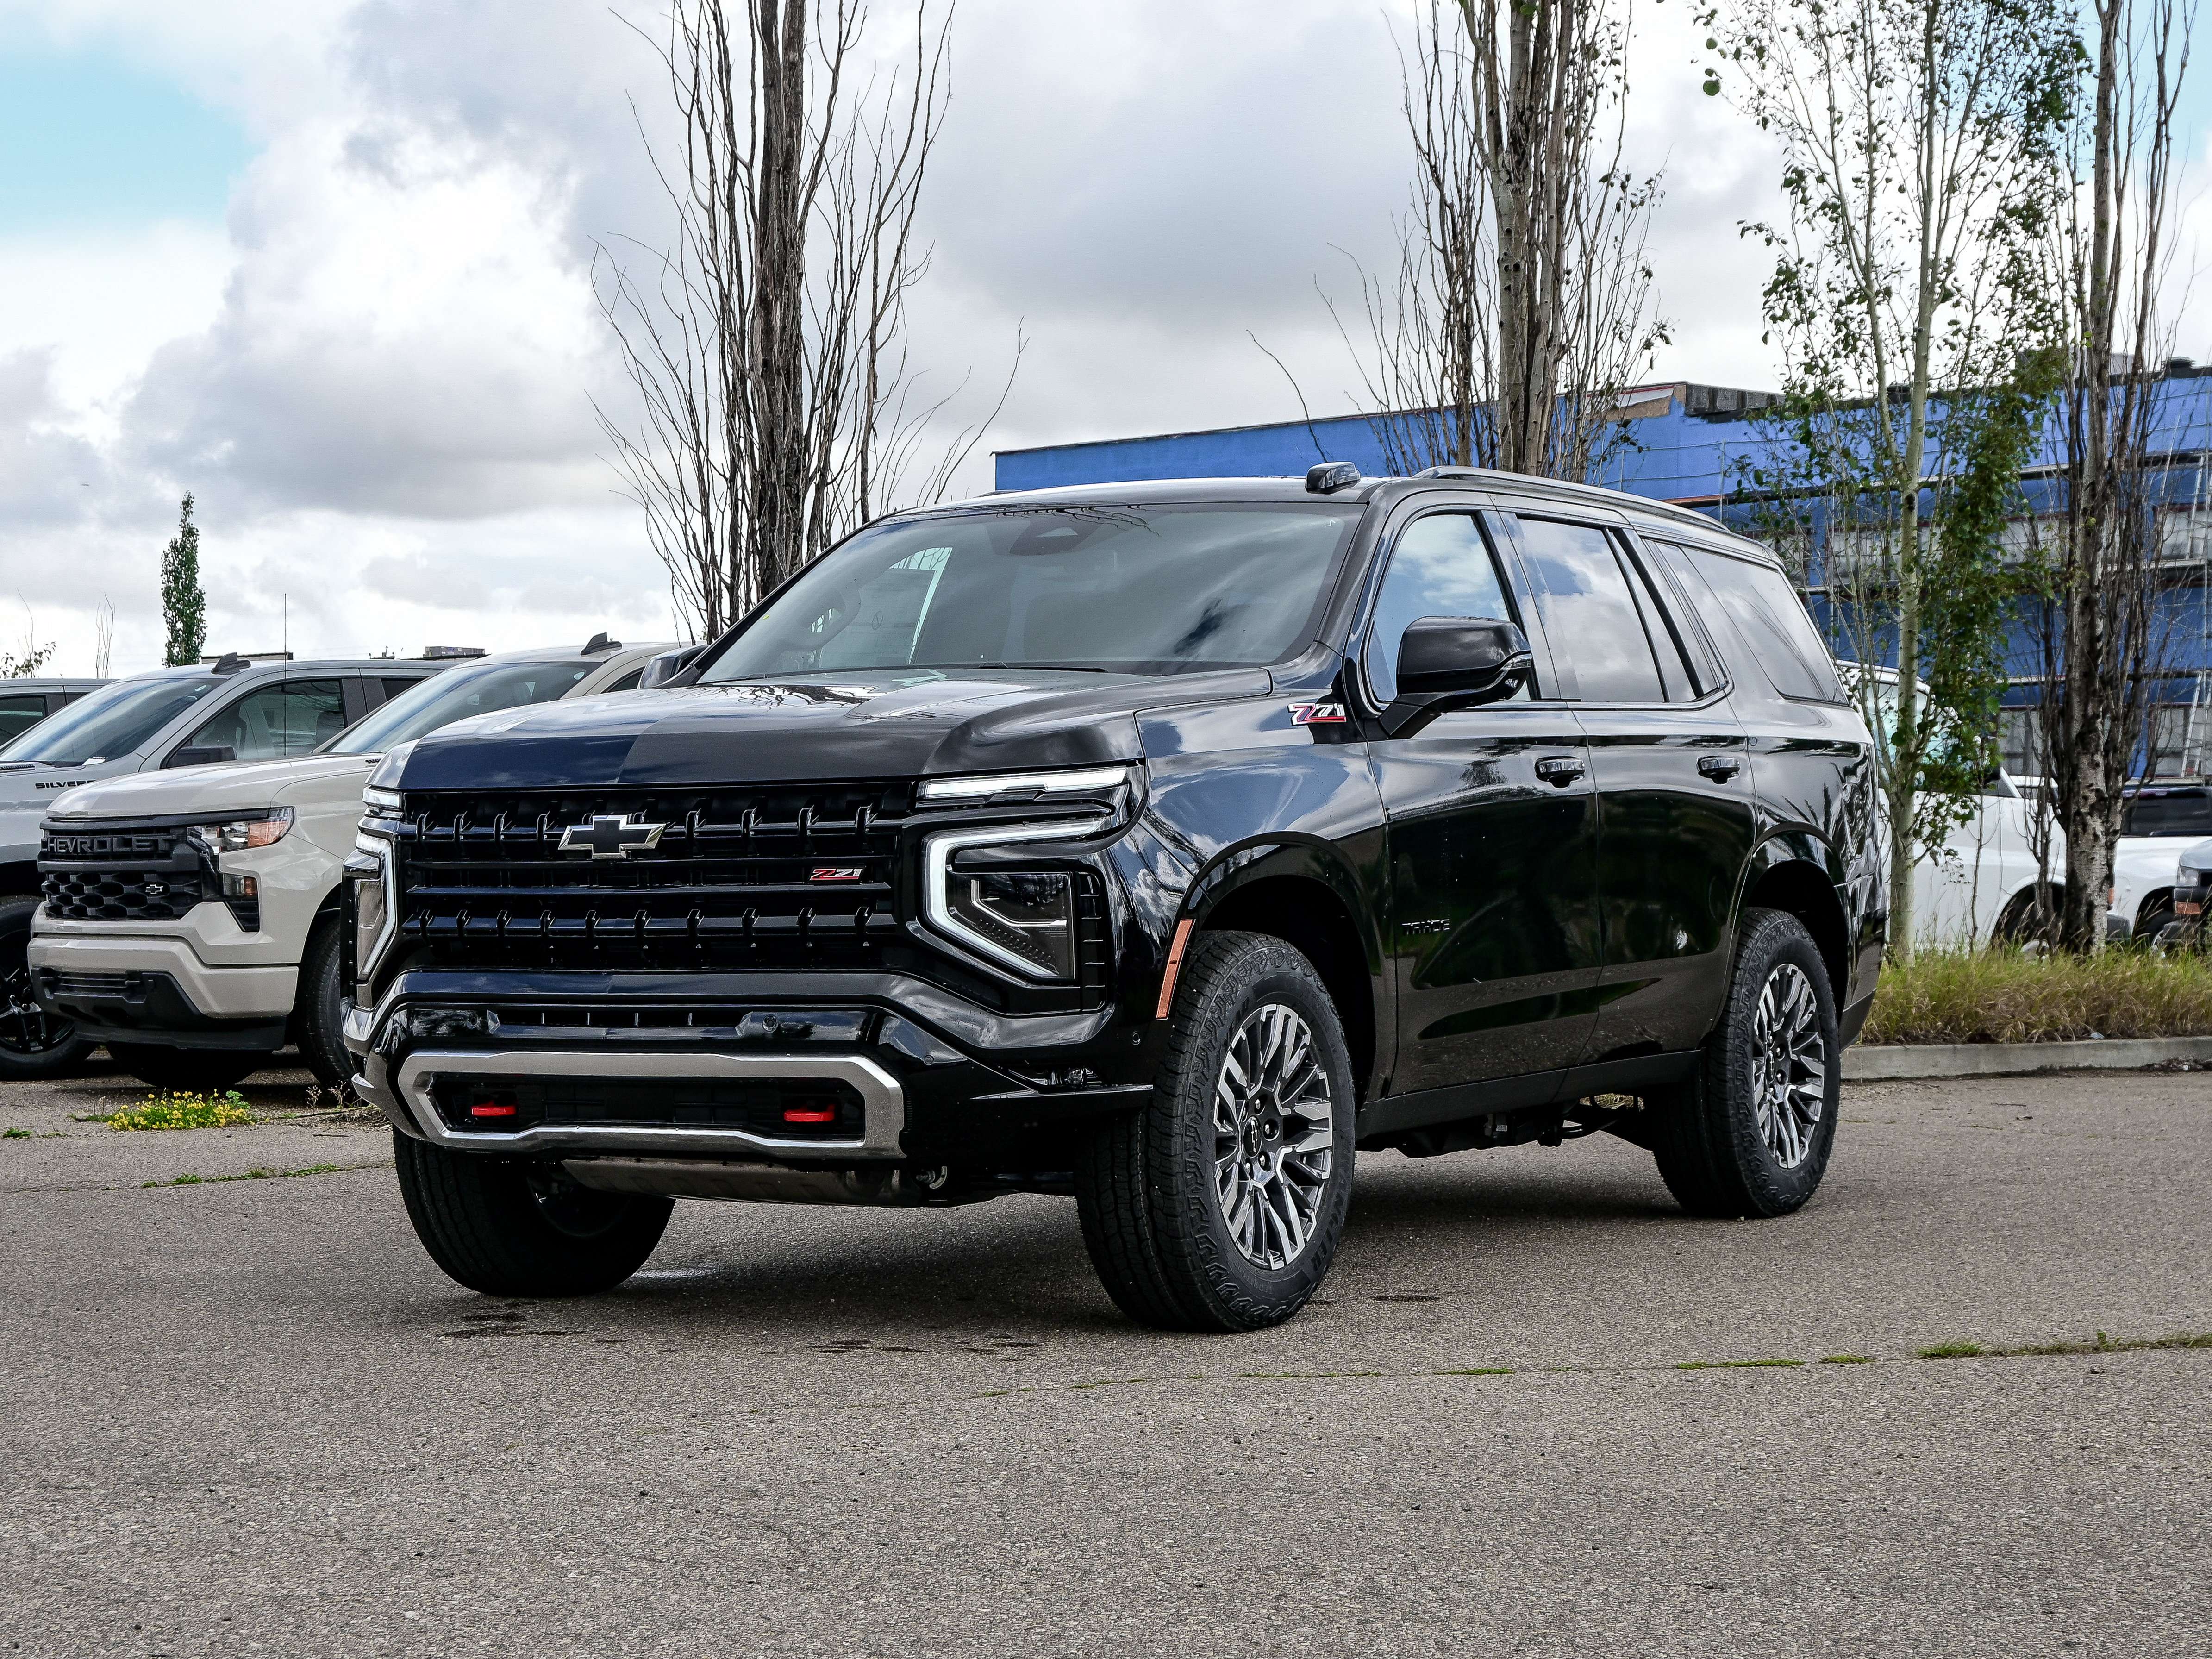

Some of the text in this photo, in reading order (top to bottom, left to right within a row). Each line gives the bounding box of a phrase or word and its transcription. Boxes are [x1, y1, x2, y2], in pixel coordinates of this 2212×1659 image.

[1288, 702, 1347, 726] Z71
[35, 780, 96, 789] SILVER
[41, 835, 176, 852] CHEVROLET
[810, 869, 863, 880] Z71
[1401, 919, 1450, 934] TAHOE
